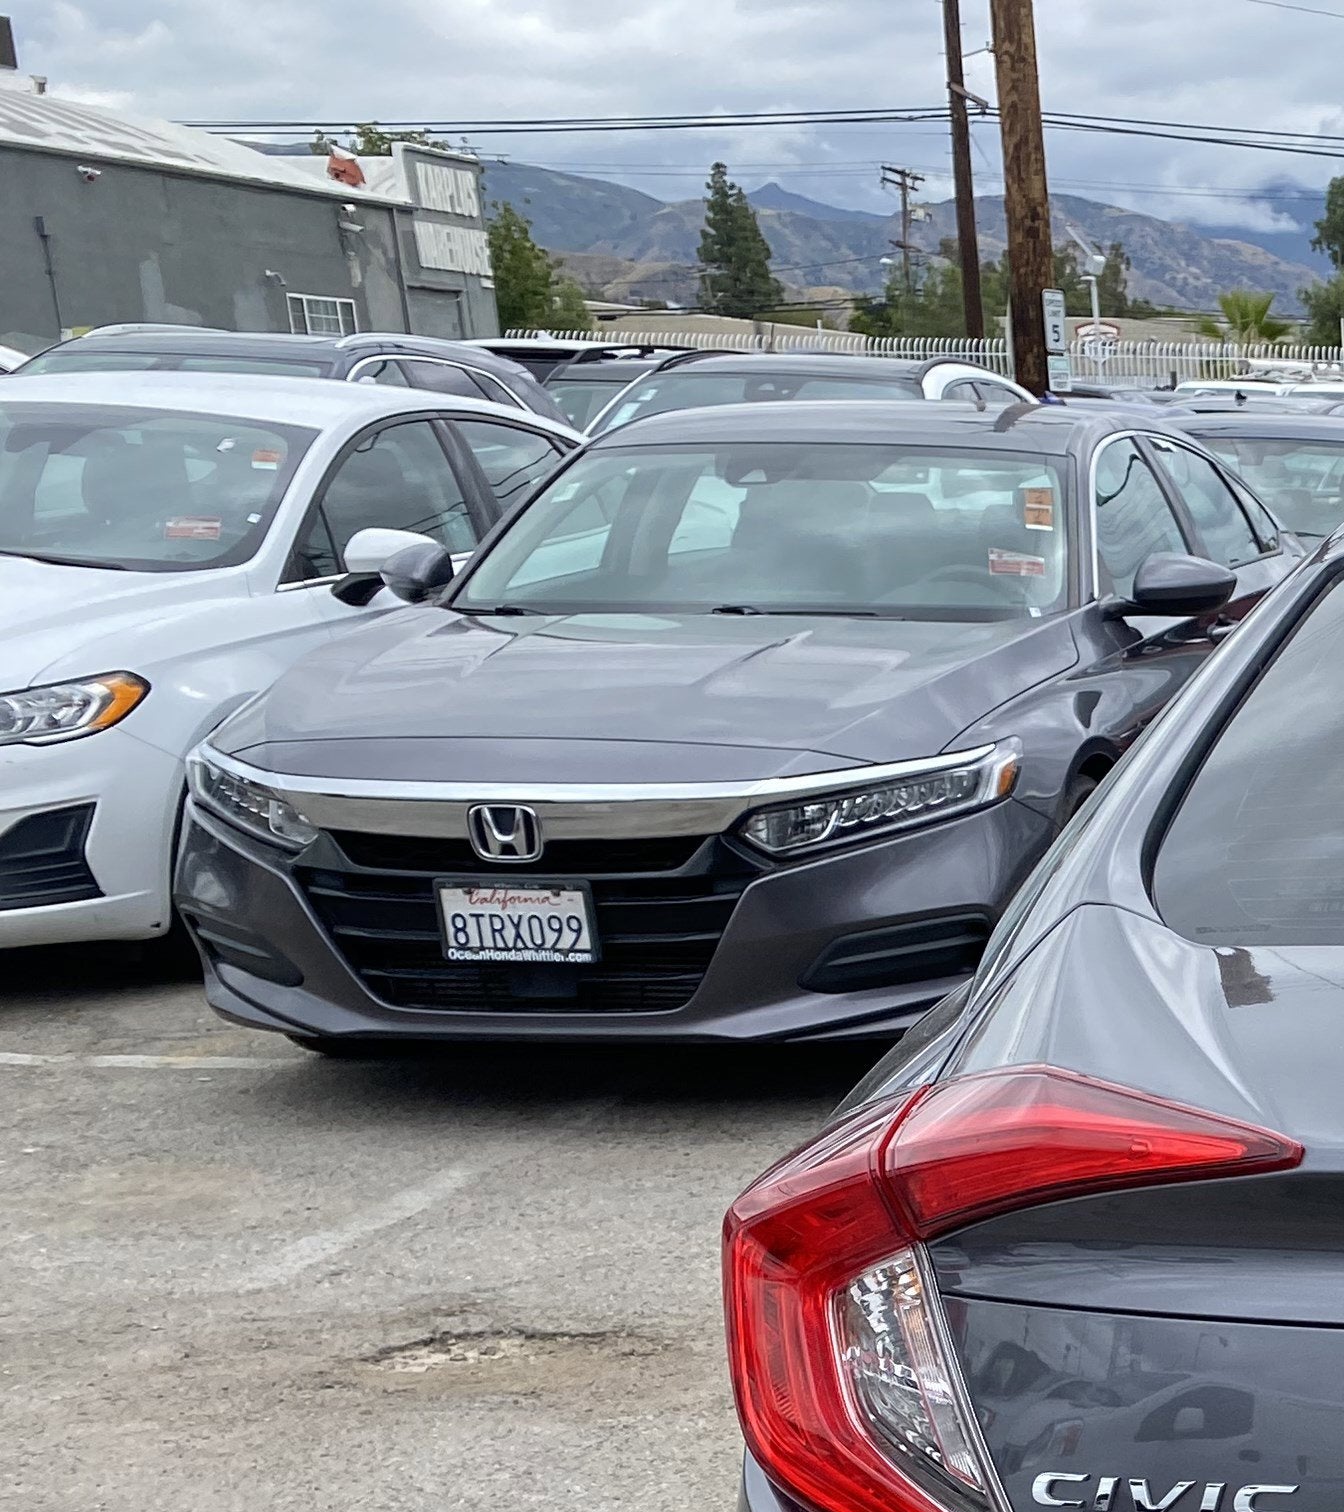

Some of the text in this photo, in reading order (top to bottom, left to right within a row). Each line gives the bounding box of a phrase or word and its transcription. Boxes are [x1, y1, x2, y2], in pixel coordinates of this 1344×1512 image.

[1052, 324, 1060, 343] 5
[468, 887, 561, 911] California
[452, 912, 583, 950] 8TRX099
